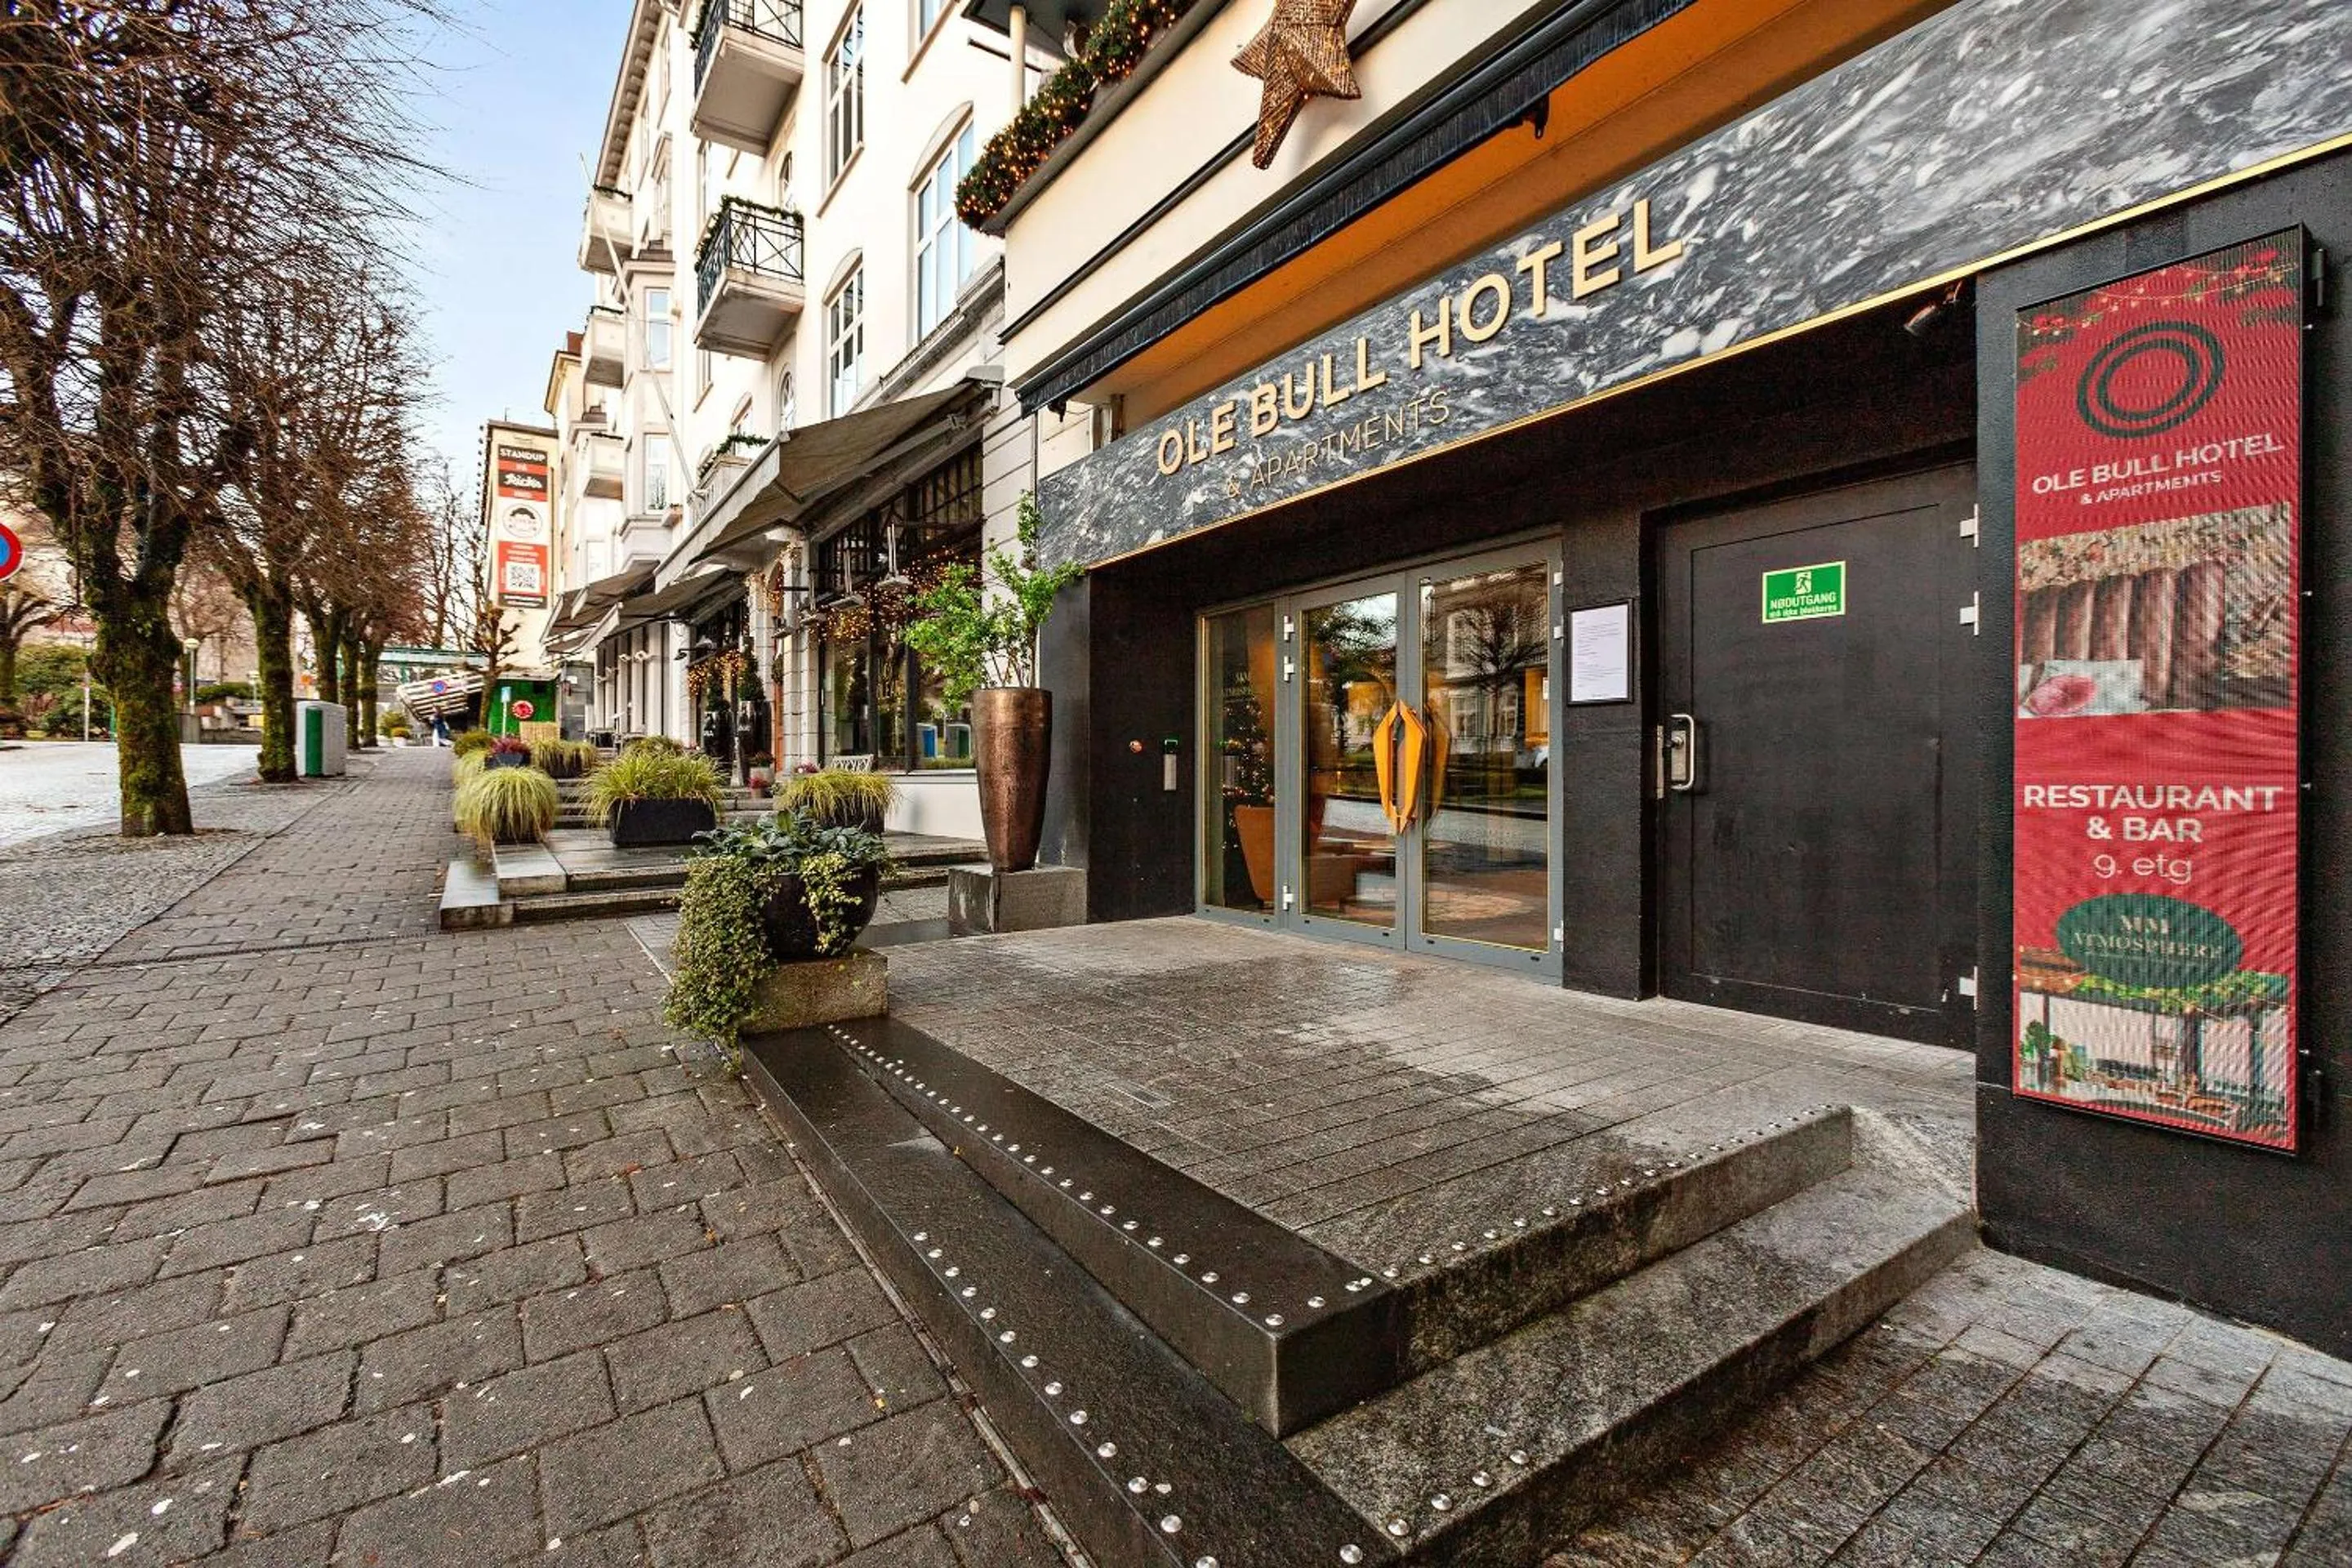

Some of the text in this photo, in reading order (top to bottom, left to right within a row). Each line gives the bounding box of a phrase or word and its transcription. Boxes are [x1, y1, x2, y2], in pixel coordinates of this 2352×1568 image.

[1158, 198, 1684, 475] OLE BULL HOTEL
[500, 448, 546, 461] STANDUP
[1226, 390, 1450, 499] & APARTMENTS
[2032, 433, 2284, 494] OLE BULL HOTEL
[2080, 470, 2222, 505] & APARTMENTS
[1771, 592, 1836, 609] NØDUTGANG
[2024, 785, 2283, 811] RESTAURANT
[2087, 817, 2203, 844] & BAR
[2092, 853, 2193, 884] 9. etg
[2071, 932, 2223, 959] ATMOSPHERE
